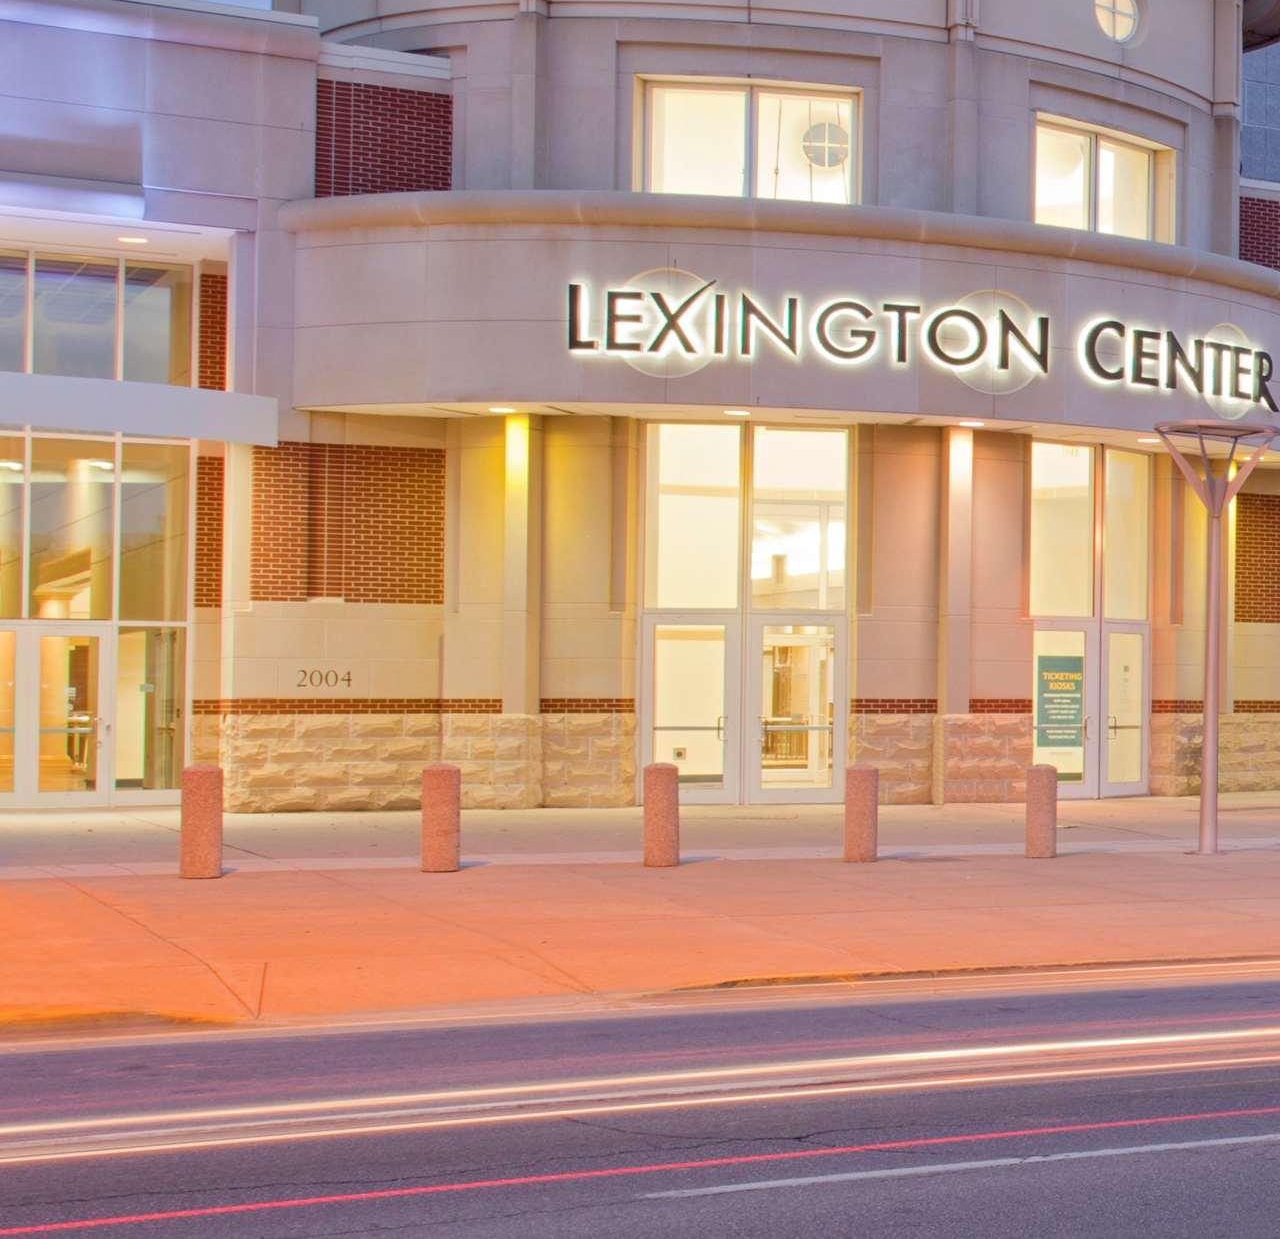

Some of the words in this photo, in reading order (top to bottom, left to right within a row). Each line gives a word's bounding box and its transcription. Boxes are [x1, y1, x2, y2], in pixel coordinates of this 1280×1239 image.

[566, 279, 1050, 374] LEXINGTON
[1083, 319, 1280, 413] CENTER
[296, 669, 353, 689] 2004
[1042, 672, 1082, 681] TICKETING
[1049, 682, 1076, 690] KIOSKS
